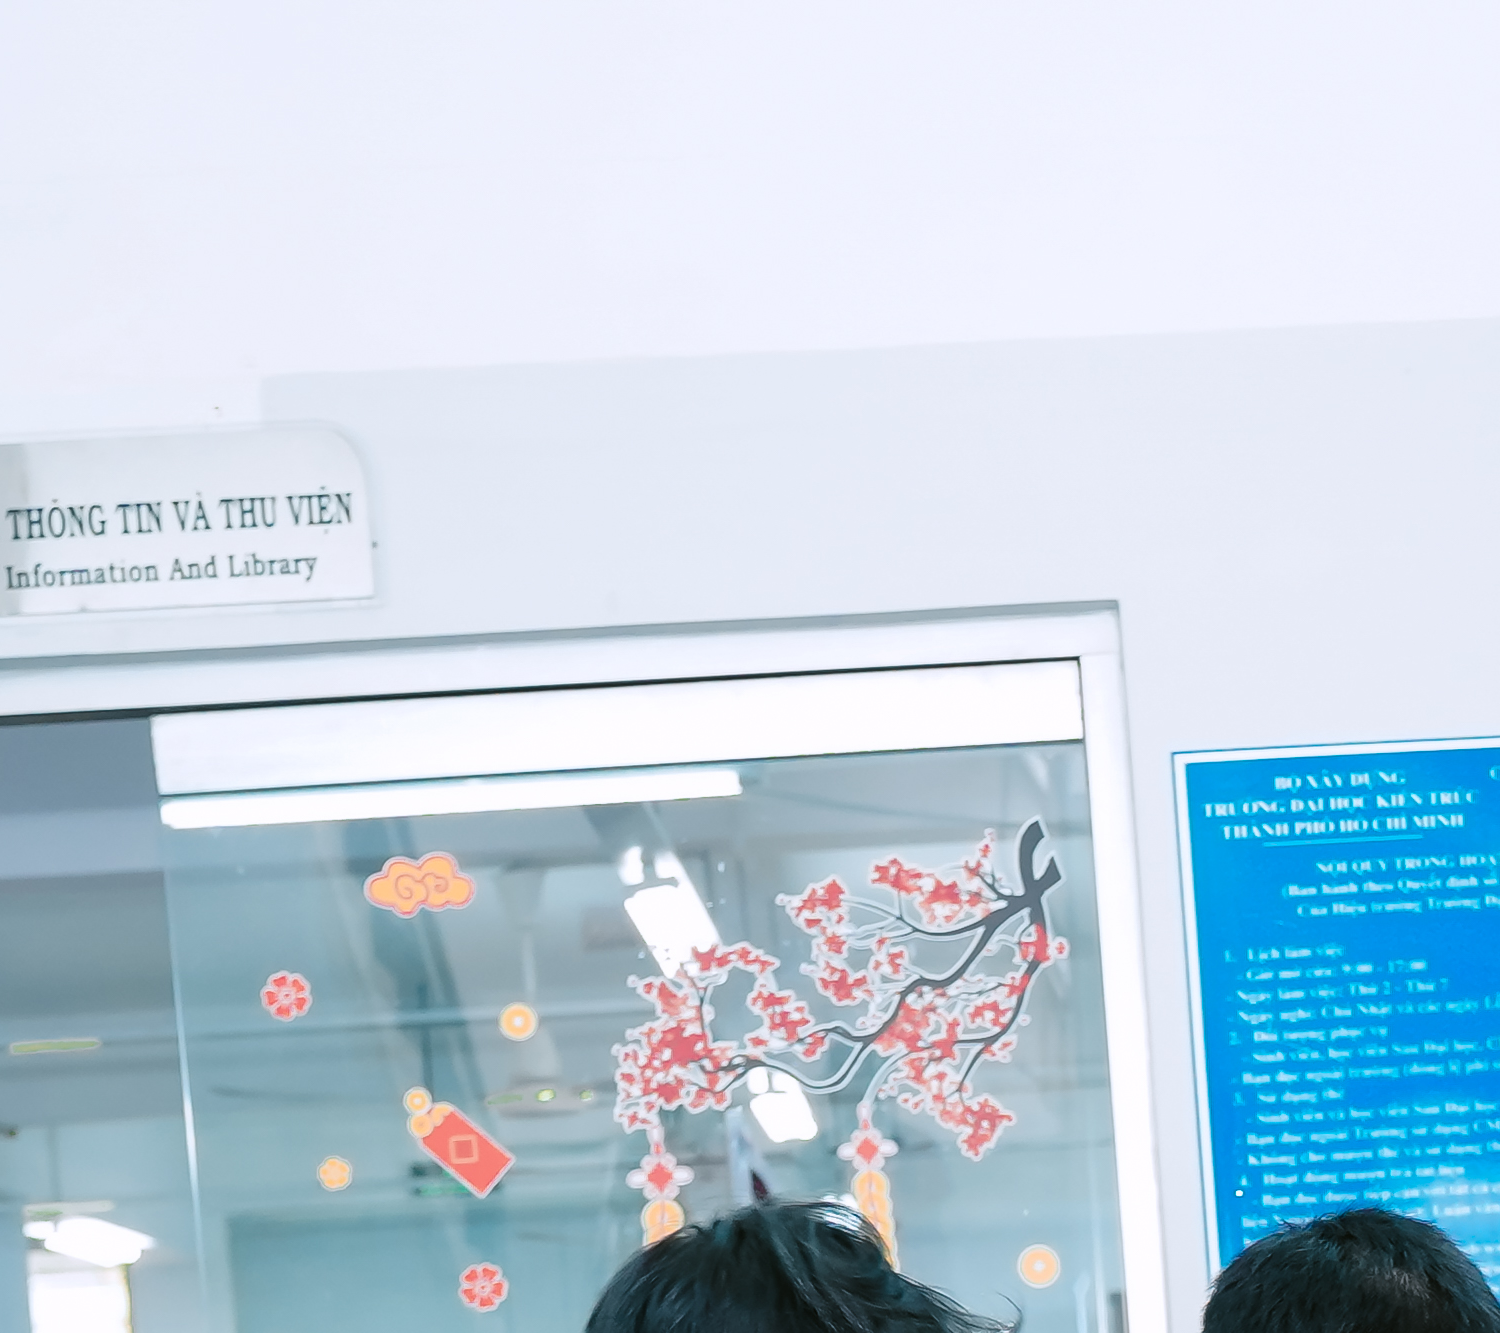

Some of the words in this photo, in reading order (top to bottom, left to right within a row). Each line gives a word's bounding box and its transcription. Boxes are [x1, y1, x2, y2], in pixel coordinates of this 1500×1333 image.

[6, 497, 107, 541] THÔNG
[115, 501, 163, 535] TIN
[172, 491, 213, 532] VÀ
[285, 486, 353, 535] VIỆN
[7, 561, 159, 590] Information
[169, 555, 218, 581] And
[228, 551, 317, 583] Library
